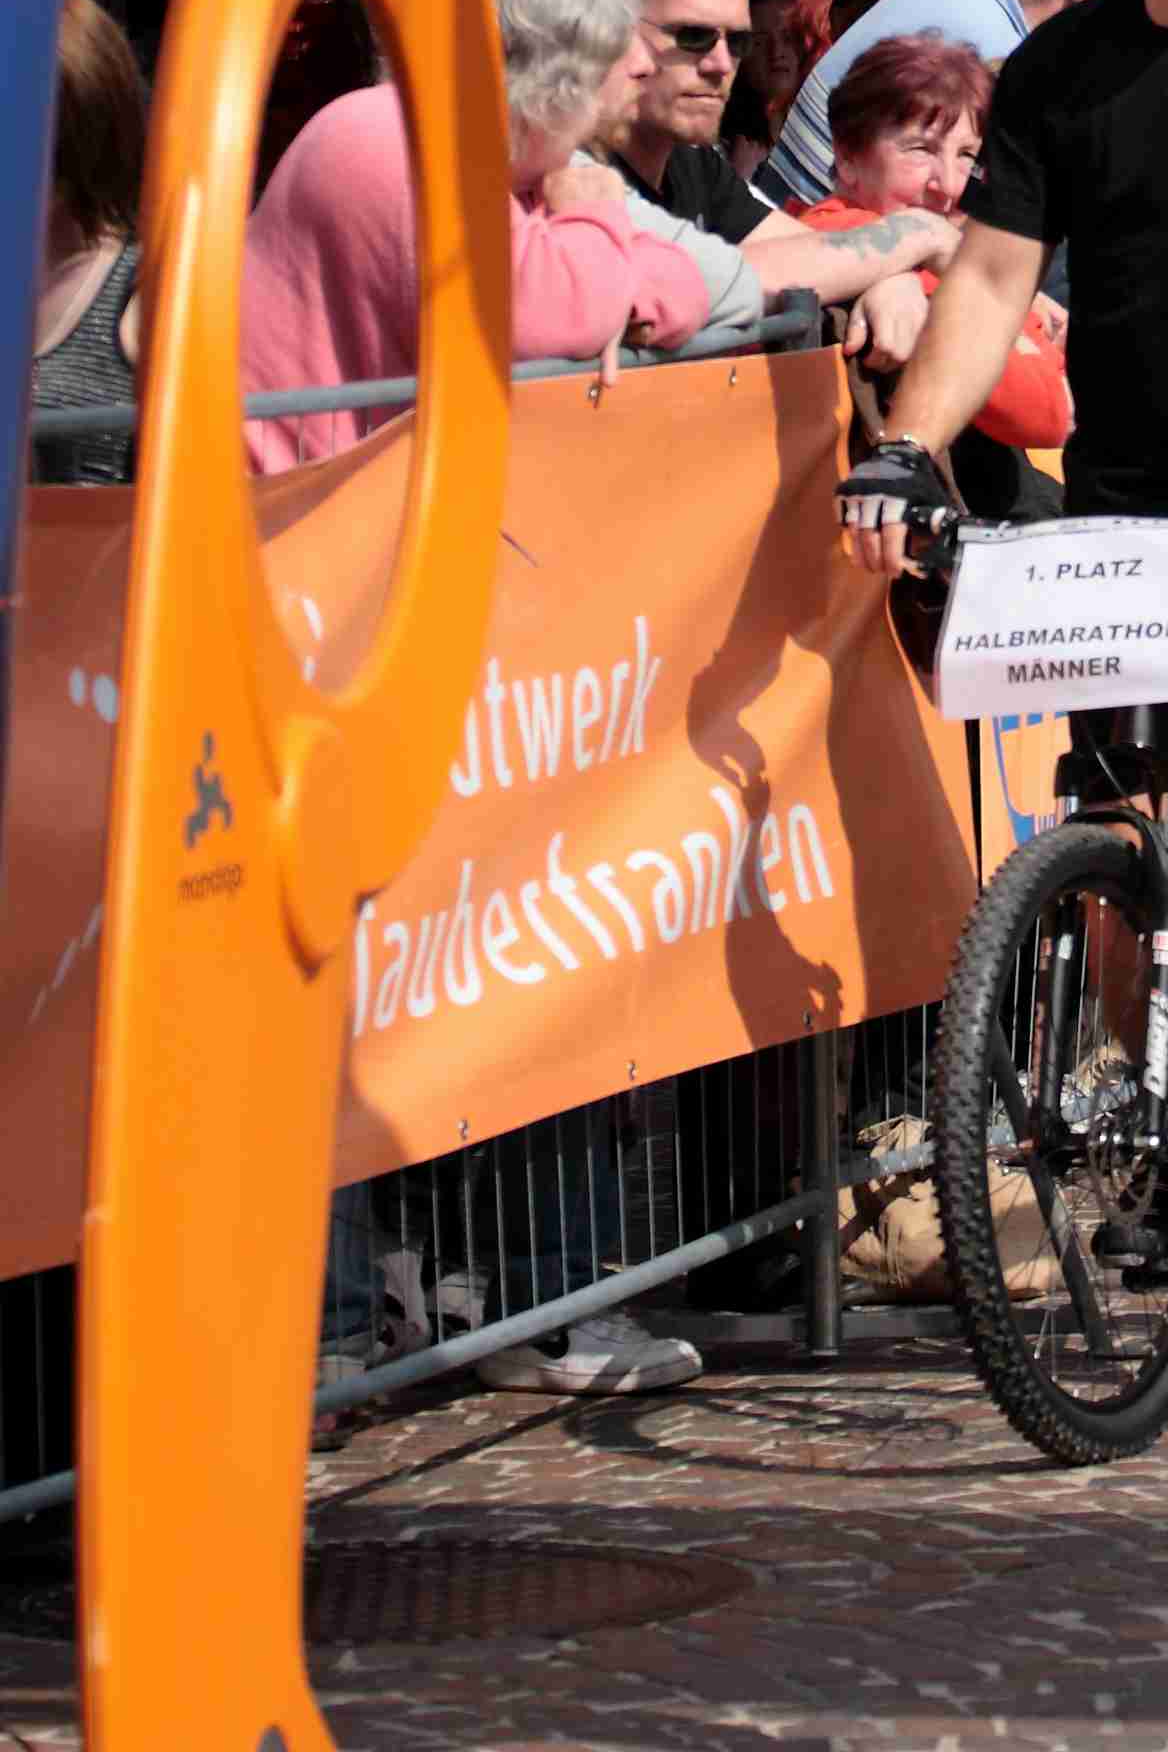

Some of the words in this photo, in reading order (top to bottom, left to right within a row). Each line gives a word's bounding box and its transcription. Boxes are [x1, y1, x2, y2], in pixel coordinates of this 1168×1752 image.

[1024, 565, 1046, 582] 1.
[1055, 559, 1144, 580] PLATZ
[1007, 656, 1121, 684] MÄNNER
